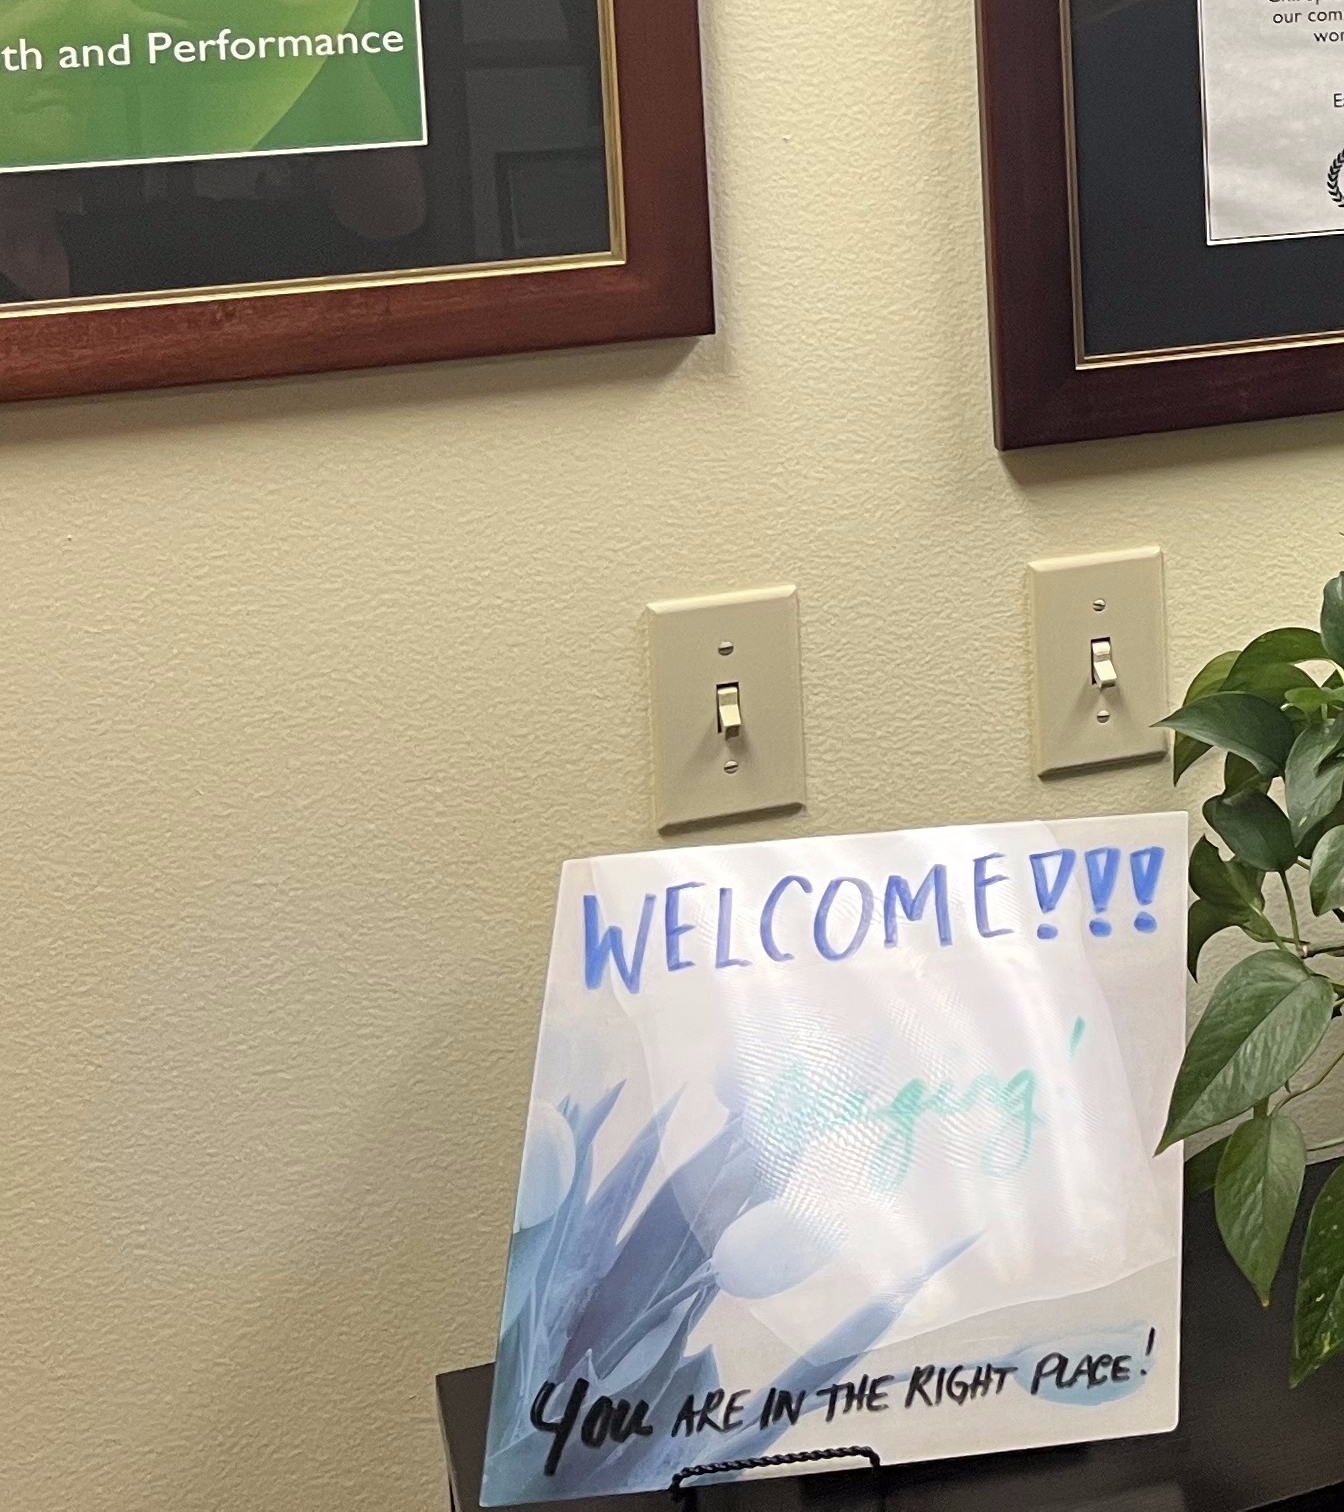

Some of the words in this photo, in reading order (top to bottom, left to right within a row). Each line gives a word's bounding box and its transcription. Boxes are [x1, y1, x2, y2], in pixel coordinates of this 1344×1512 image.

[1273, 12, 1303, 24] our
[58, 33, 131, 68] and
[148, 28, 405, 65] Performance
[671, 1388, 751, 1437] ARE
[759, 1387, 806, 1430] IN
[816, 1374, 895, 1423] THE
[905, 1363, 1019, 1408] RIGHT
